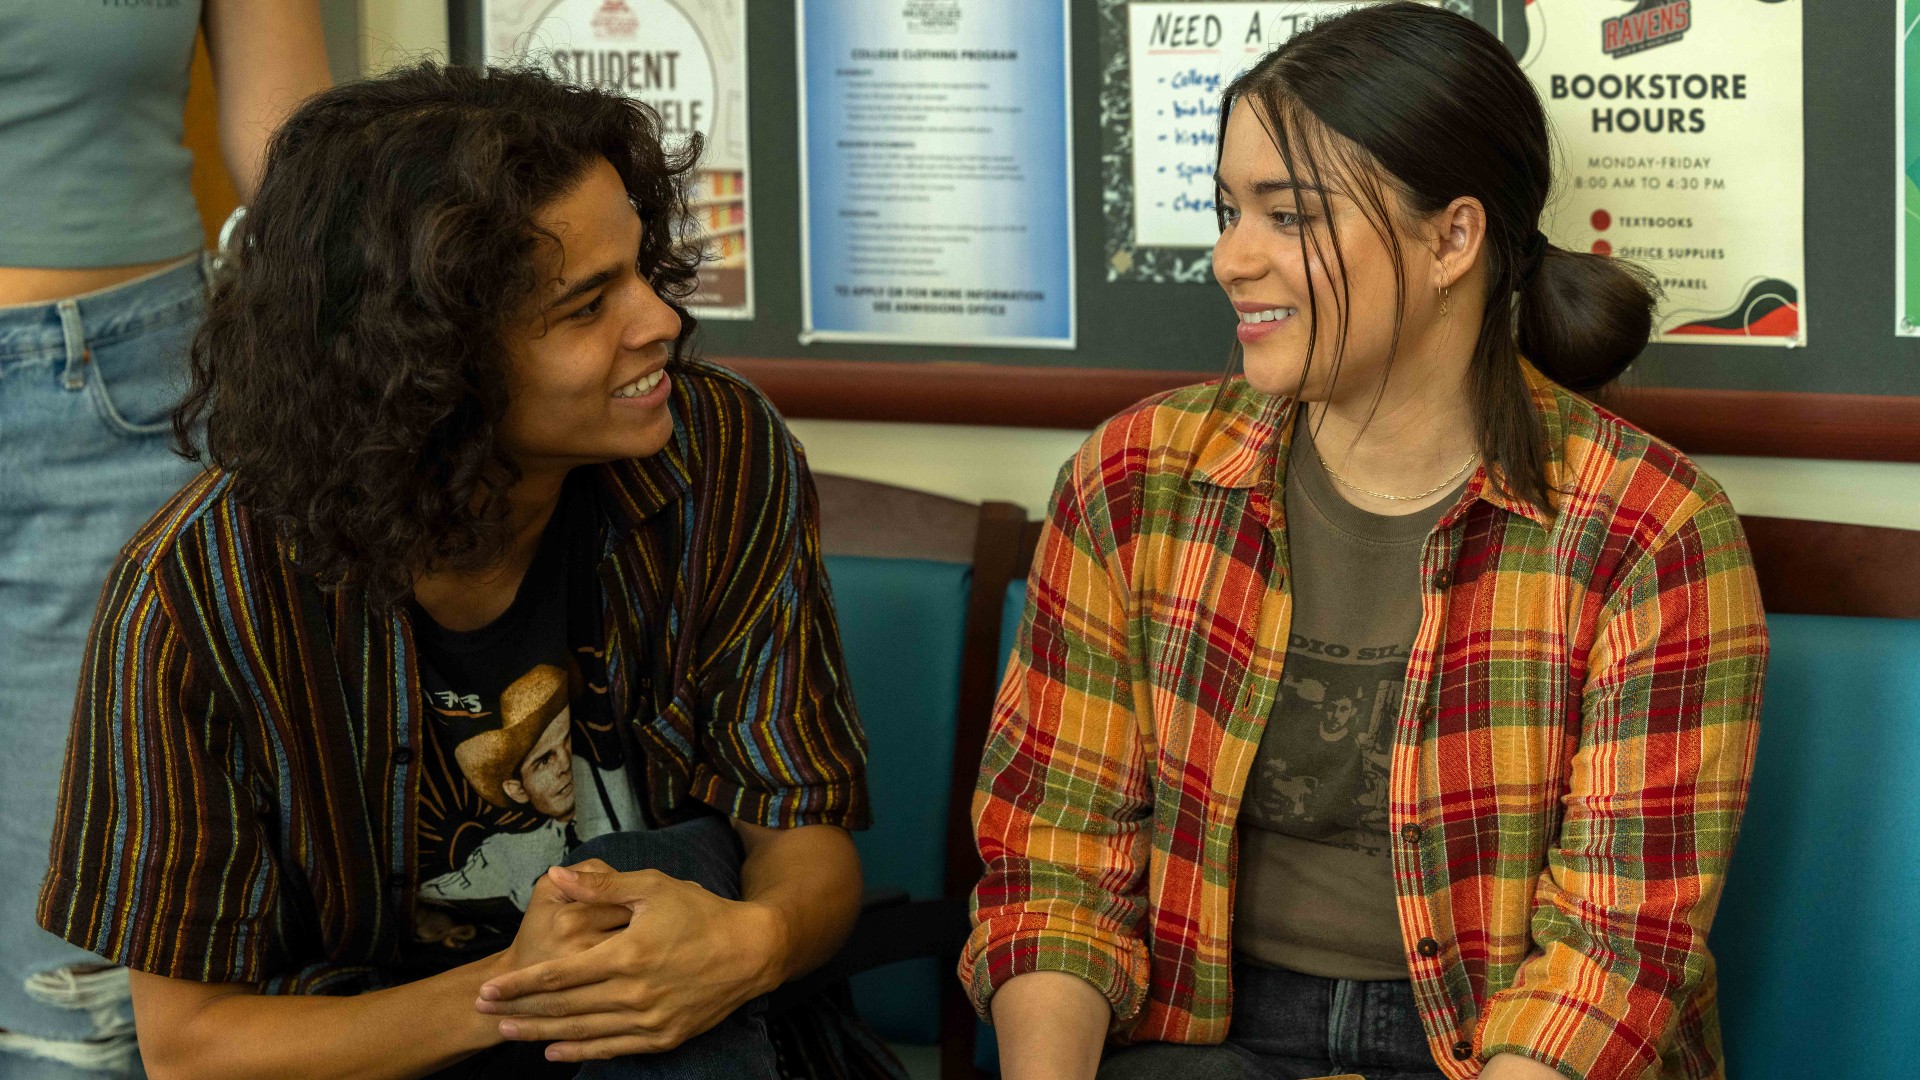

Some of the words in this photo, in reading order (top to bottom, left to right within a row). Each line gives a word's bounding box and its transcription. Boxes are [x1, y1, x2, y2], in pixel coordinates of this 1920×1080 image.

[1149, 12, 1222, 47] NEED
[1245, 10, 1261, 43] A
[1605, 1, 1688, 51] RAVENS
[902, 50, 958, 61] CLOTHING
[961, 51, 1018, 61] PROGRAM
[553, 51, 680, 90] STUDENT
[1551, 74, 1746, 99] BOOKSTORE
[1592, 108, 1706, 133] HOURS
[1588, 156, 1711, 169] MONDAY-FRIDAY
[1575, 177, 1607, 189] 8:00
[1612, 177, 1635, 189] AM
[1642, 177, 1661, 190] TO
[1666, 177, 1699, 190] 4:30
[1704, 178, 1726, 190] PM
[1619, 216, 1693, 228] TEXTBOOKS
[1620, 247, 1664, 259] OFFICE
[1668, 248, 1725, 260] SUPPLIES
[1357, 644, 1412, 660] SIL
